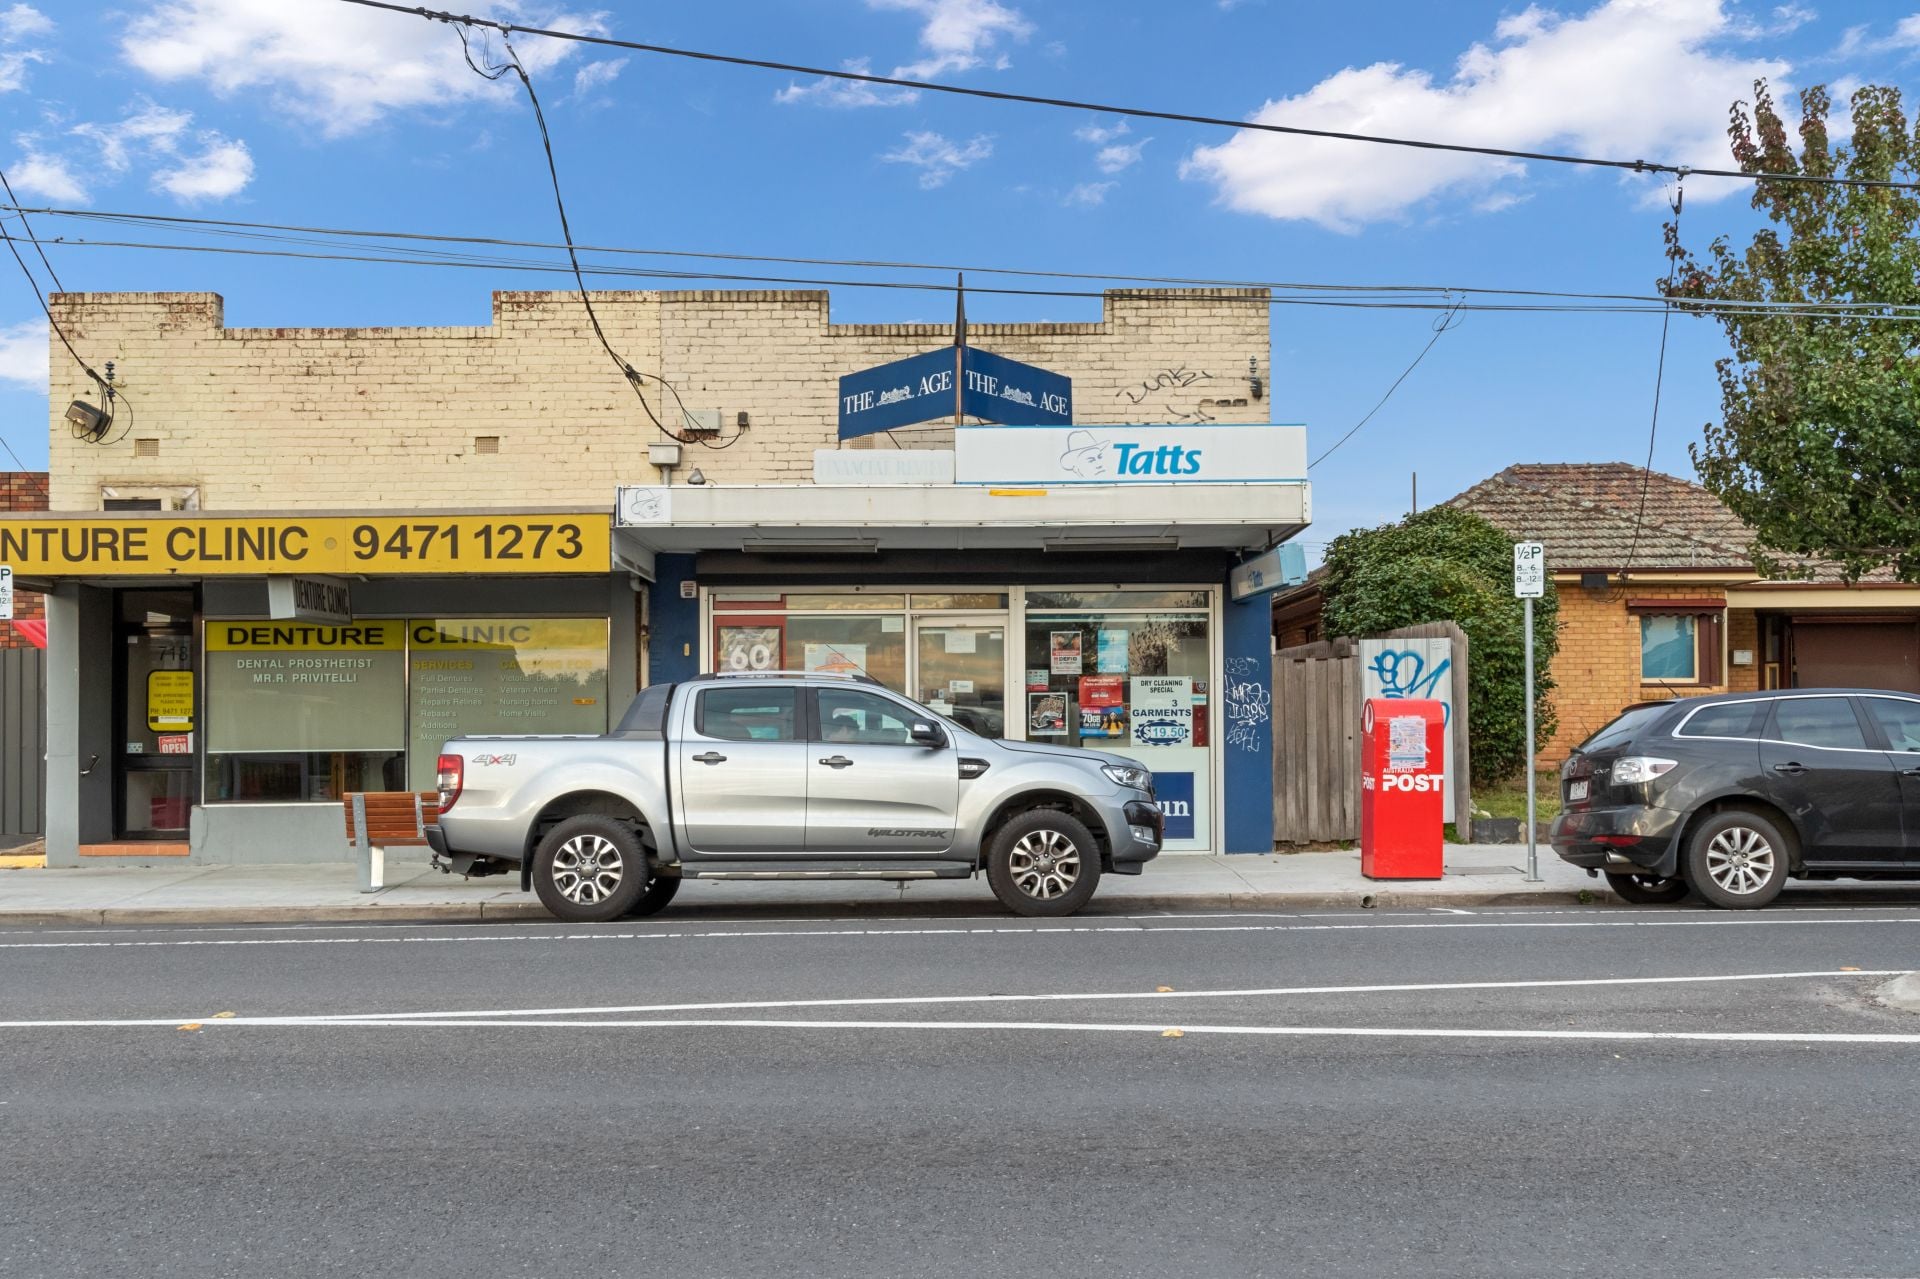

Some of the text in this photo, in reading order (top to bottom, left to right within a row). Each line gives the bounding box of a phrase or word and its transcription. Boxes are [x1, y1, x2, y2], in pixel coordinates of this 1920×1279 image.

[843, 370, 952, 415] THE AGE
[965, 369, 1068, 416] THE AGE
[1113, 443, 1202, 475] Tatts
[166, 526, 309, 562] CLINIC
[352, 524, 460, 560] 9471
[473, 523, 584, 559] 1273
[294, 578, 349, 615] DENTURE CLINIC
[227, 625, 531, 646] DENTURE CLINIC
[158, 646, 189, 661] 718
[237, 658, 373, 669] DENTAL PROSTHETIST
[413, 660, 474, 671] SERVICES
[292, 673, 357, 683] PRIVITELLI
[420, 674, 473, 683] Full Dentures
[1140, 679, 1184, 687] DRY CLEANING
[420, 686, 485, 695] Partial Dentures
[500, 686, 558, 695] Veteran Affairs
[1149, 686, 1175, 694] SPECIAL
[420, 698, 452, 707] Repairs
[500, 698, 558, 707] Nursing homes
[1171, 699, 1178, 707] 3
[420, 709, 457, 718] Rebase's
[500, 709, 546, 718] Home Visits
[1132, 708, 1192, 717] GARMENTS
[420, 721, 457, 730] Additions
[162, 743, 187, 754] OPEN
[1382, 773, 1445, 792] POST
[867, 827, 948, 840] WILDTRAK
